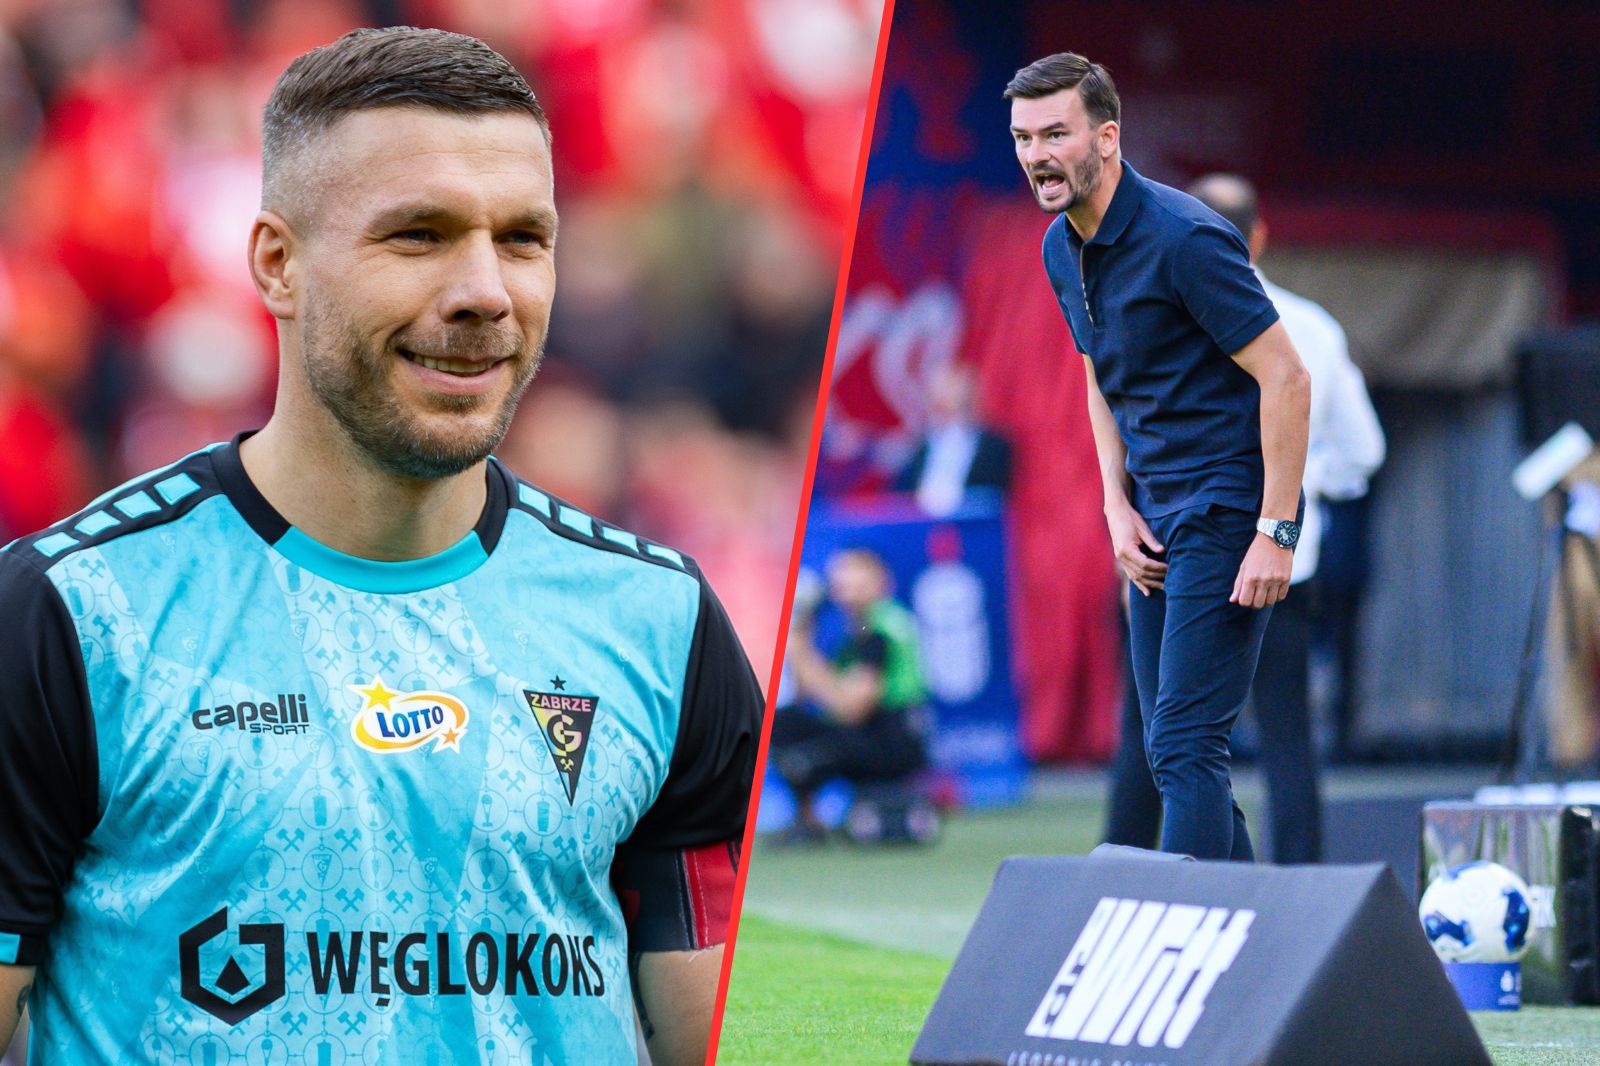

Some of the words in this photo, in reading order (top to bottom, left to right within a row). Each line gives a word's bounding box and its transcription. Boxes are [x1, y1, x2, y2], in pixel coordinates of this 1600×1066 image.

[191, 693, 310, 731] capelli
[530, 693, 592, 713] ZABRZE
[248, 722, 310, 736] SPORT
[375, 705, 445, 739] LOTTO
[306, 931, 606, 1007] WĘGLOKOKS
